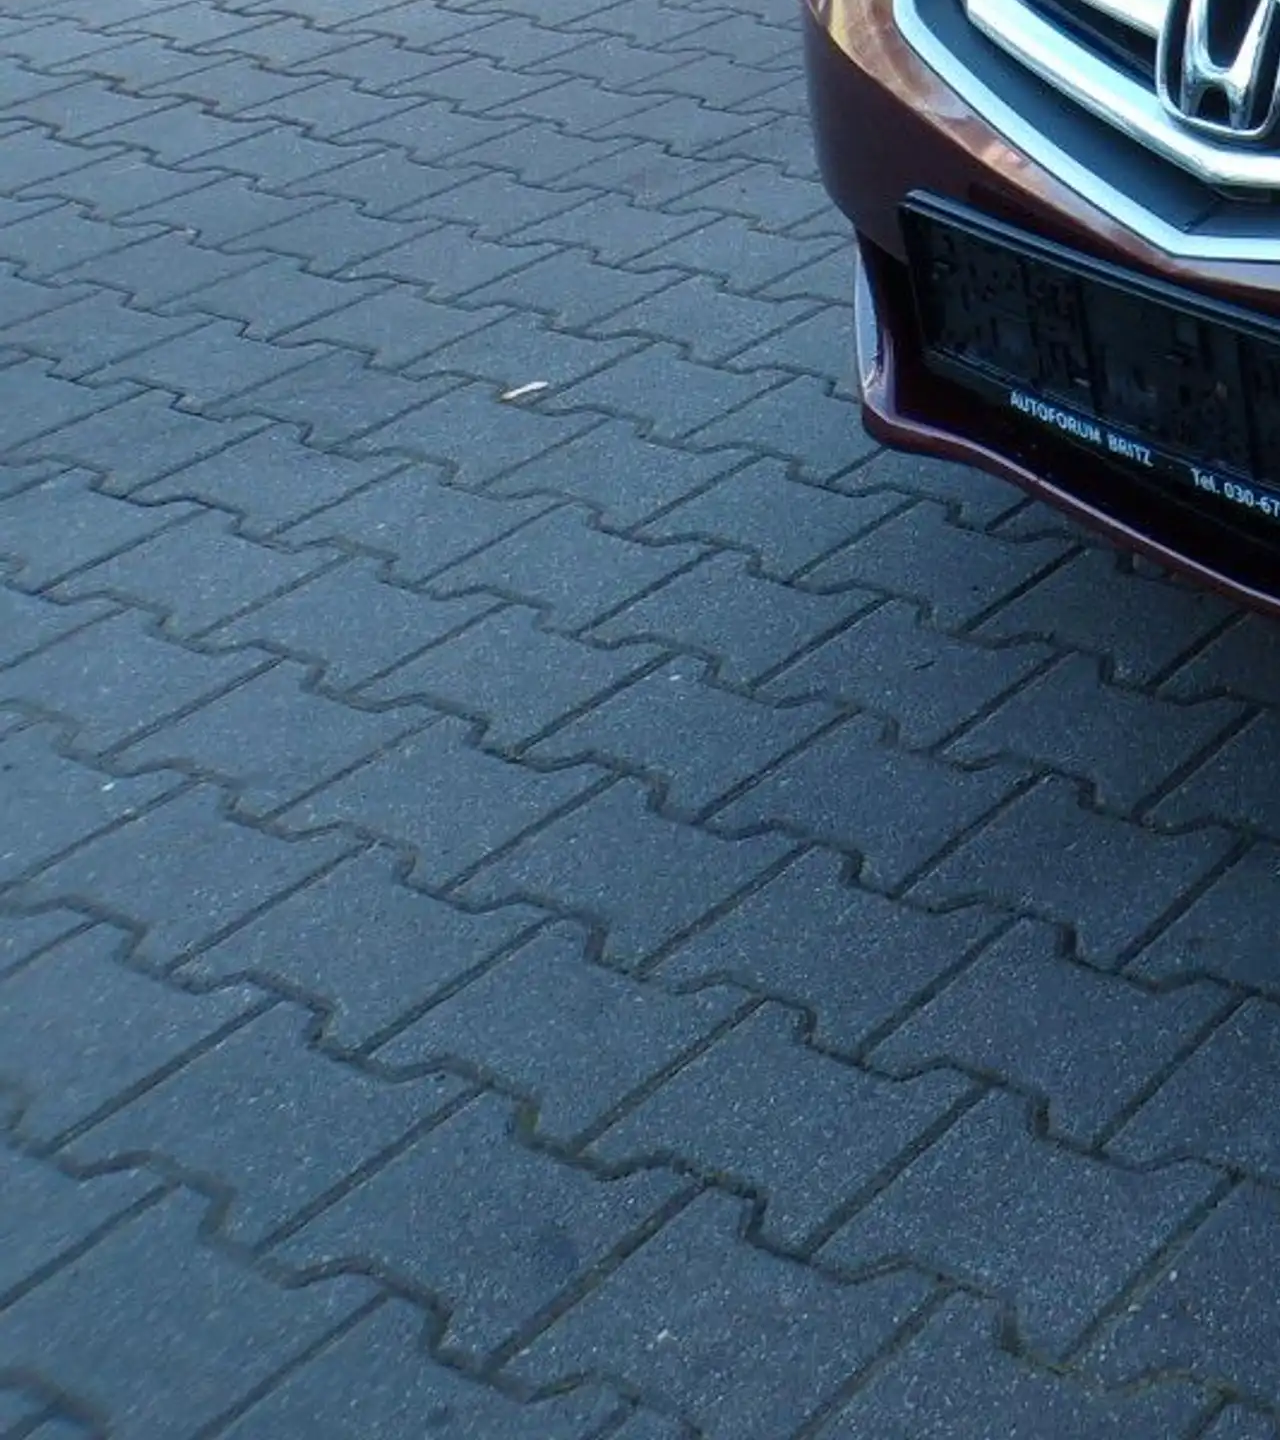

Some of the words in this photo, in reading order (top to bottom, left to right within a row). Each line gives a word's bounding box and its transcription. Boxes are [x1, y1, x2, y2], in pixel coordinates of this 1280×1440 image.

[1010, 391, 1101, 444] AUTOFORUM
[1107, 433, 1154, 467] BRITZ
[1190, 466, 1220, 495] Tel.
